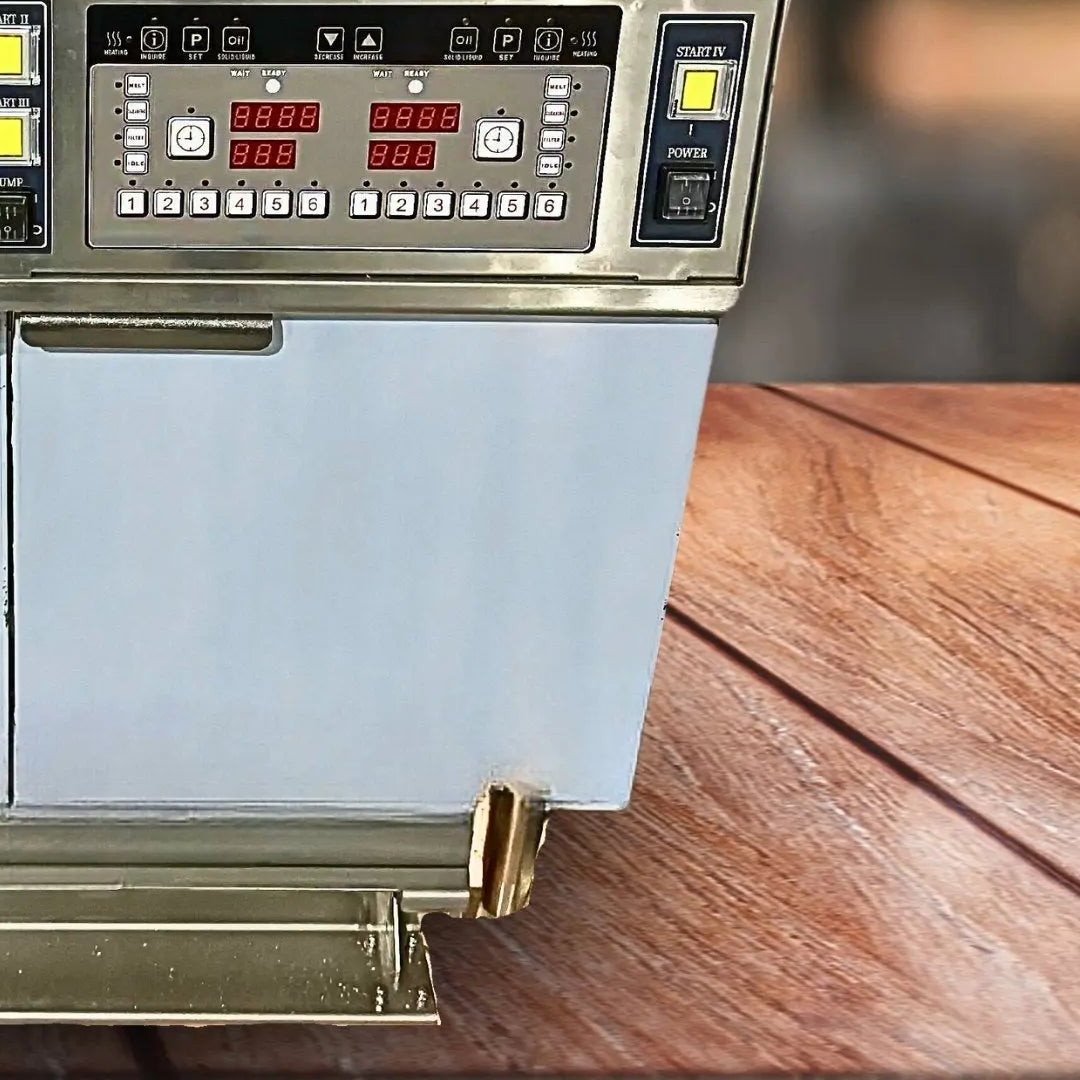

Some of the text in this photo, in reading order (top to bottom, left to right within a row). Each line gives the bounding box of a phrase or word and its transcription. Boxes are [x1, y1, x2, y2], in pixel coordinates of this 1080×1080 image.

[20, 14, 29, 24] II
[191, 33, 203, 46] P
[228, 36, 244, 46] Oil
[502, 34, 514, 47] P
[676, 46, 726, 57] START IV
[372, 70, 393, 78] WAIT
[18, 98, 30, 108] III
[667, 147, 708, 159] POWER
[128, 197, 318, 211] 1 2 3 4 5 6
[361, 198, 555, 213] 1 2 3 4 5 6
